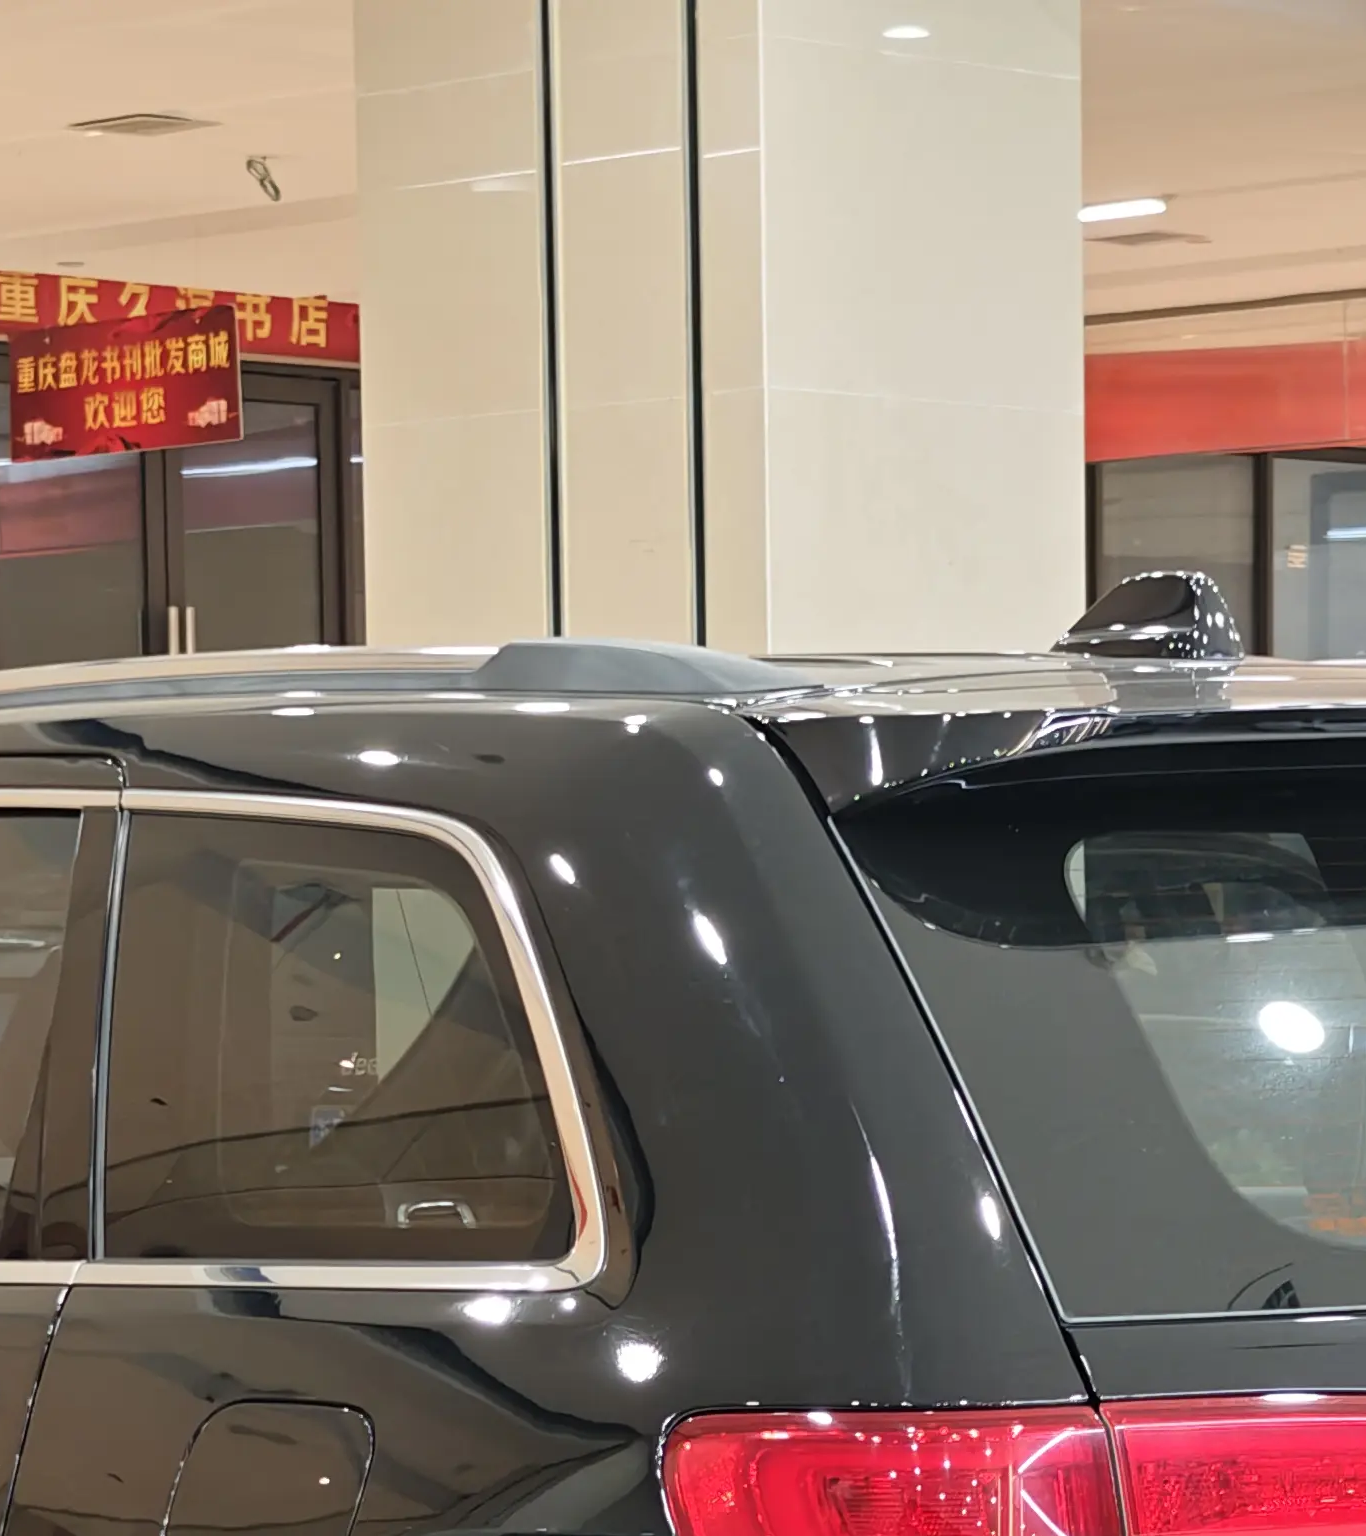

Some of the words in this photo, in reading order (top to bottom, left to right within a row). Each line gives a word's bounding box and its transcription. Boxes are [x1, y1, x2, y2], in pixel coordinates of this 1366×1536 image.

[16, 330, 231, 394] 重庆盘龙书刊批发商城
[84, 386, 166, 432] 欢迎您
